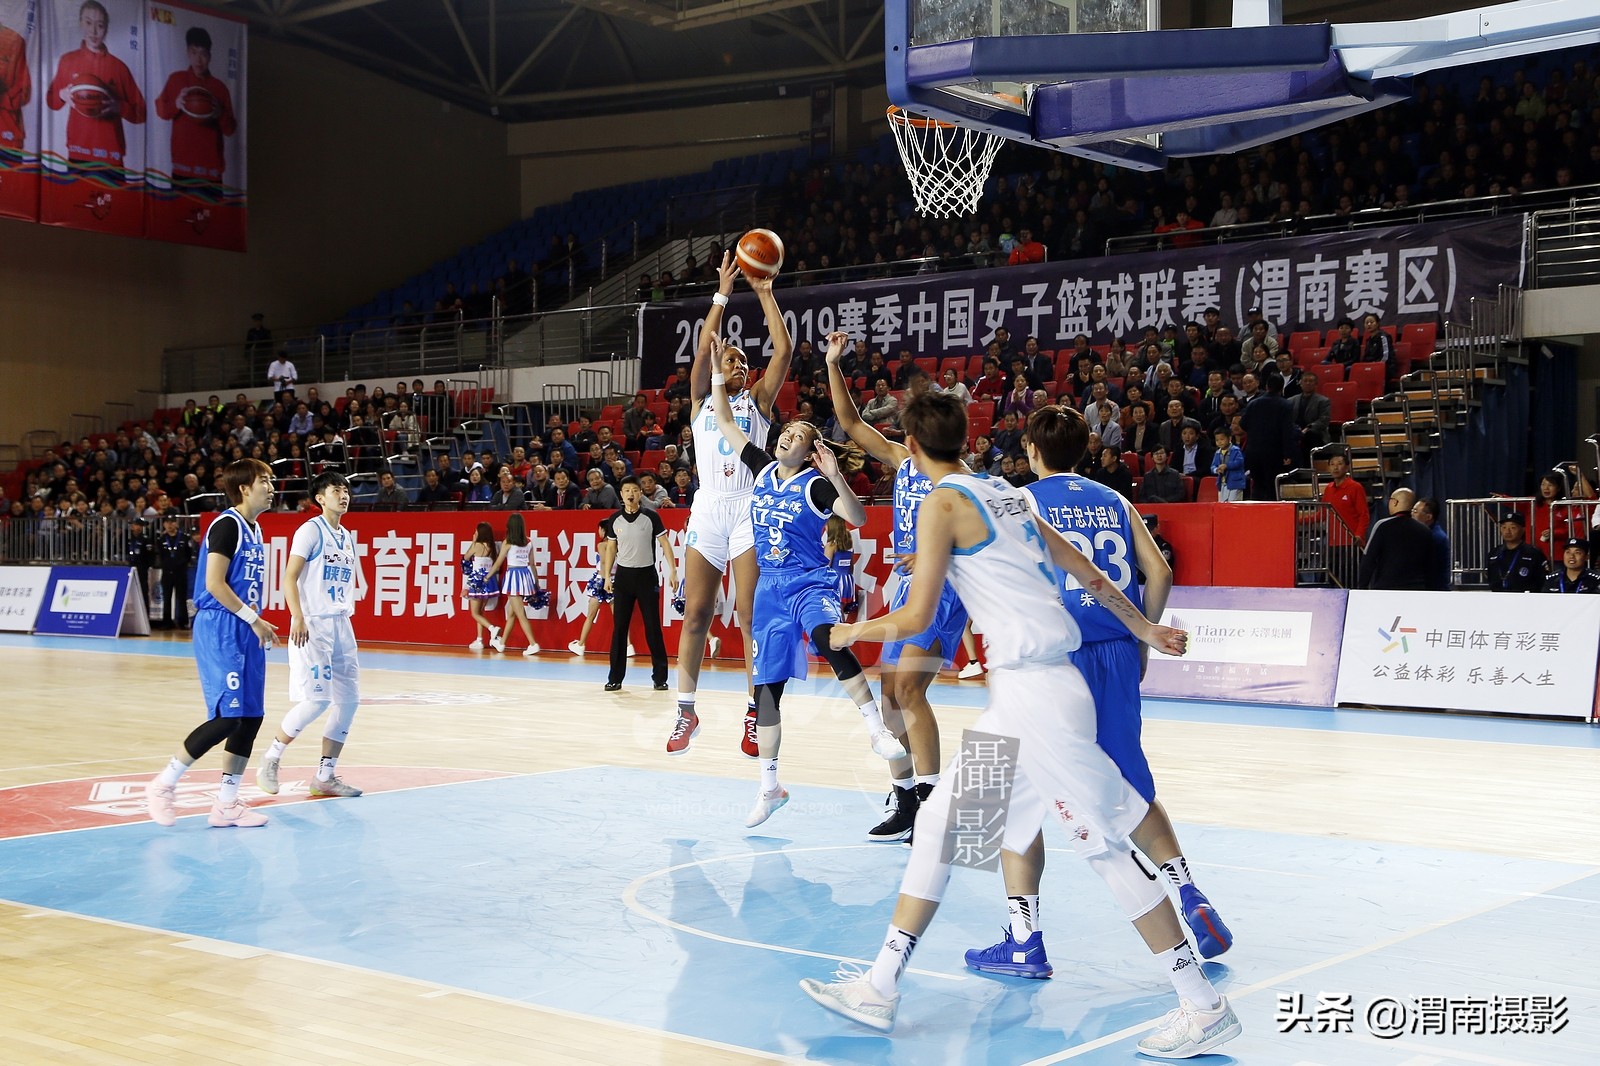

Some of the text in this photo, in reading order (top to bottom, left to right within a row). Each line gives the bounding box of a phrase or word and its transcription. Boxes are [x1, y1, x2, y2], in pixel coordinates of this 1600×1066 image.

[753, 507, 794, 528] 辽宁
[899, 509, 914, 532] 34
[1048, 505, 1121, 529] 辽宁忠大铝业
[768, 527, 783, 546] 9
[323, 565, 352, 583] 陕西
[247, 581, 259, 602] 6
[327, 585, 346, 603] 13
[1195, 624, 1246, 637] Tianze
[1195, 636, 1224, 644] GROUP
[1425, 629, 1561, 652] 中国体育彩票
[226, 671, 240, 690] 6
[311, 664, 332, 681] 13
[1372, 662, 1556, 687] 公益体彩 乐善人生
